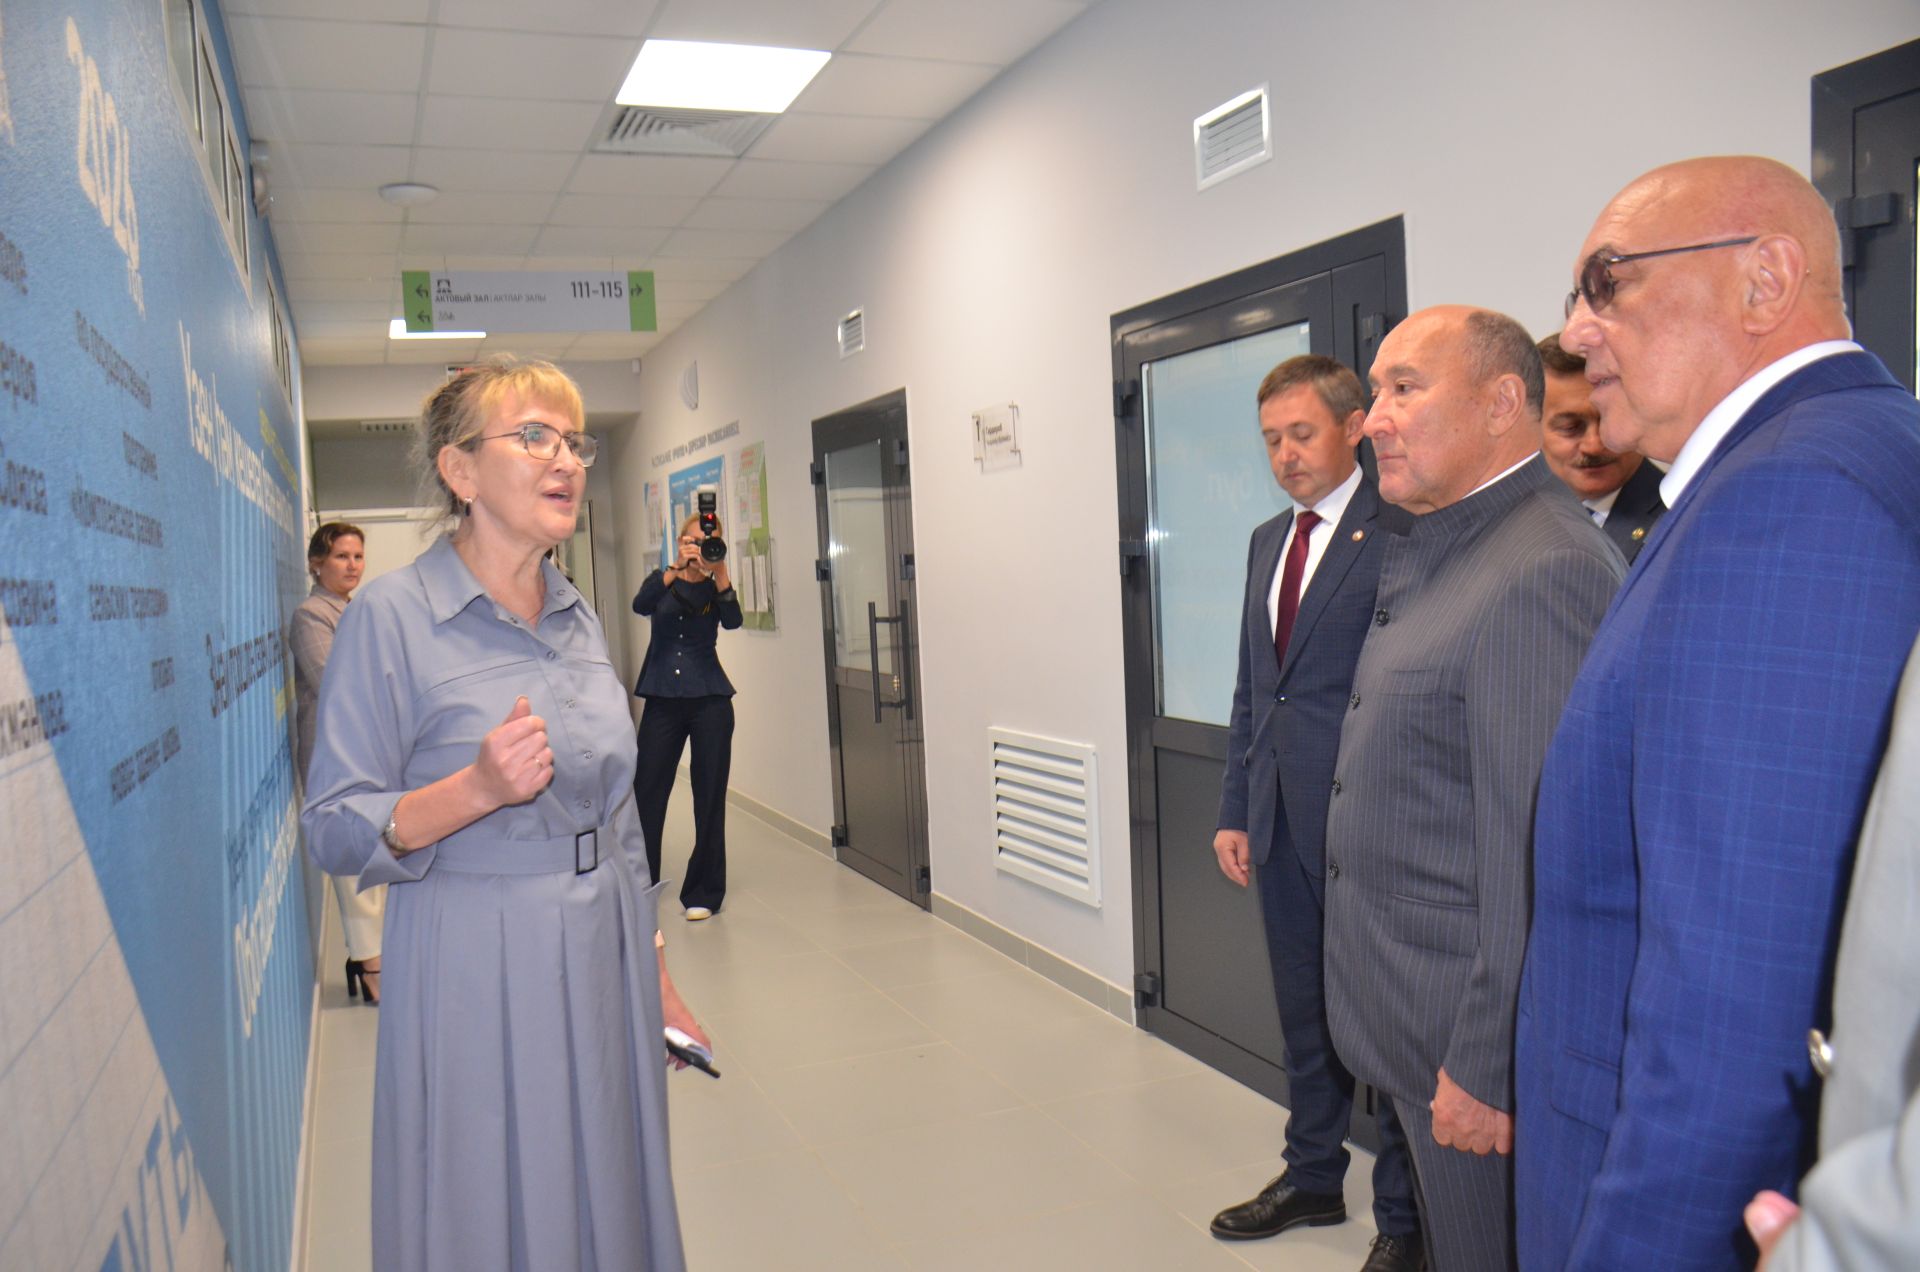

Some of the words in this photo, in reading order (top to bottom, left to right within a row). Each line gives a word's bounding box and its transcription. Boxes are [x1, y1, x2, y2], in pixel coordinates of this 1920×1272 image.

[570, 280, 623, 299] 111-115
[435, 293, 472, 304] АКТОВЫЙ
[473, 294, 489, 303] ЗАЛ
